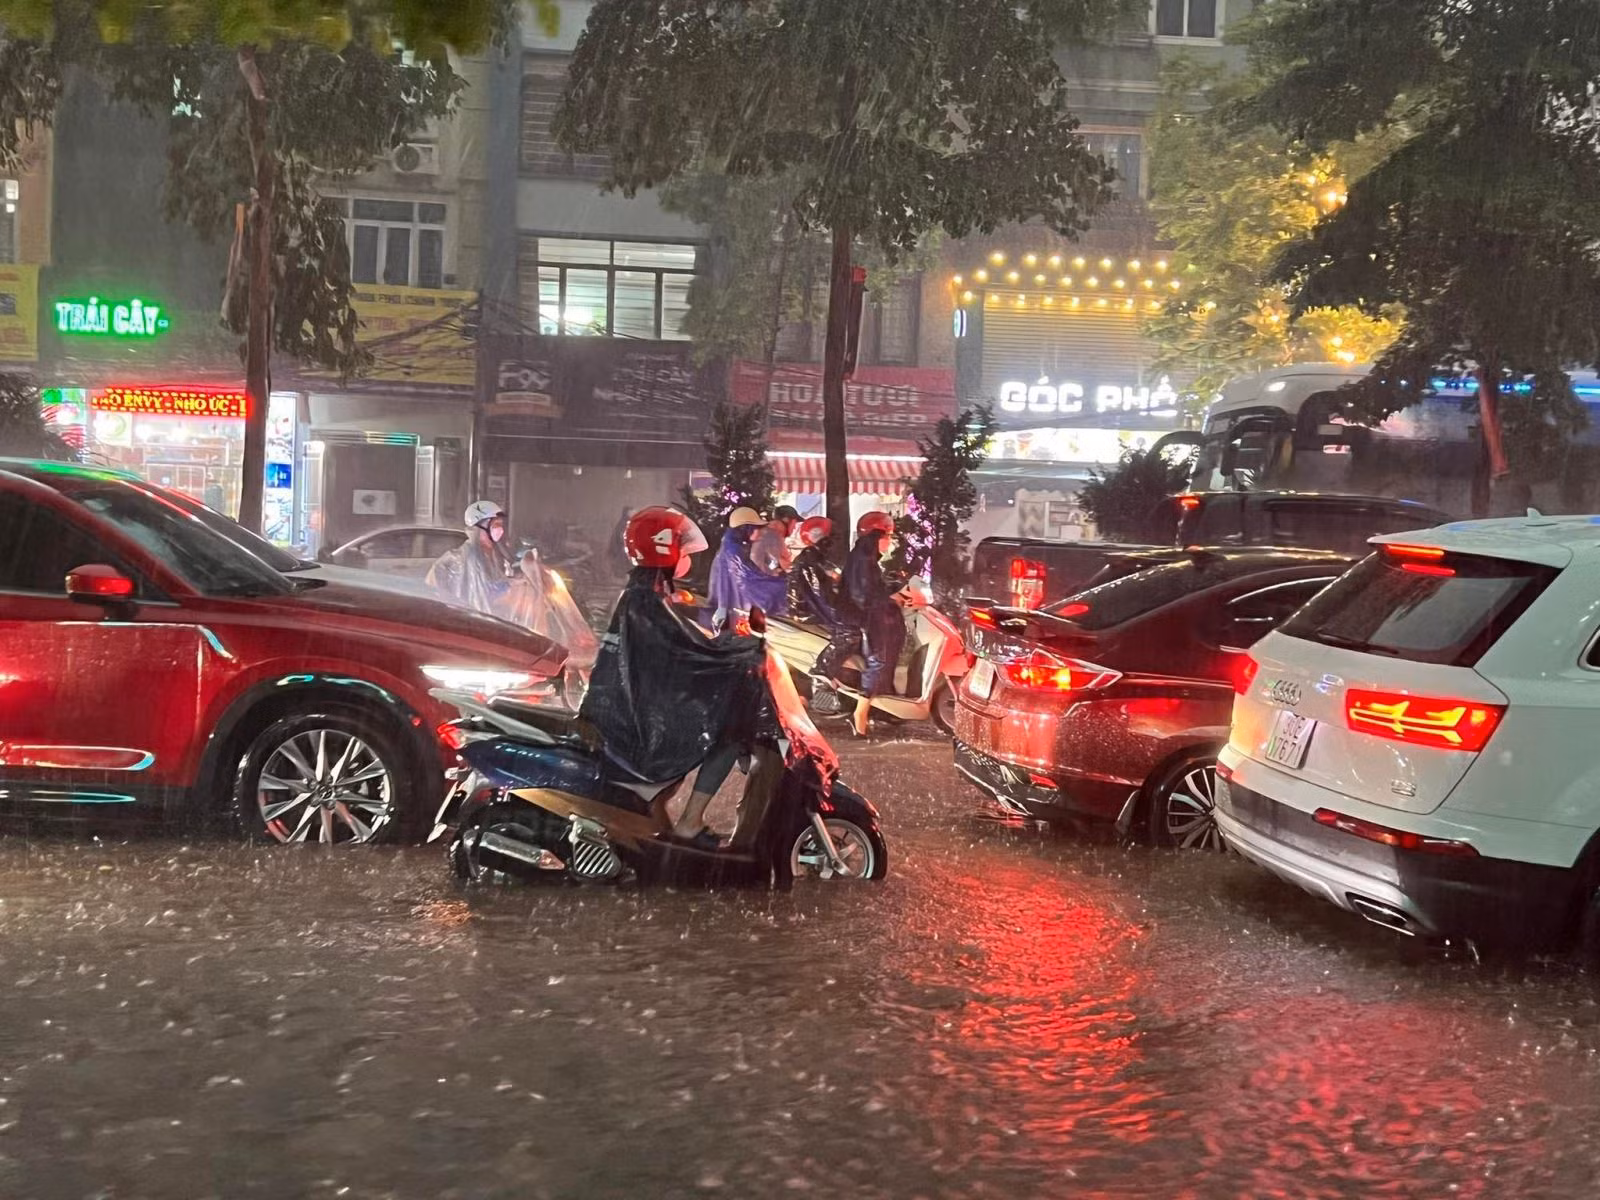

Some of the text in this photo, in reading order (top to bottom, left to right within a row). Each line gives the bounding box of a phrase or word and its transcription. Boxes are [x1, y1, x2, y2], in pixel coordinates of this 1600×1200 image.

[124, 394, 163, 408] ENVY
[174, 397, 206, 410] NHO
[1000, 375, 1084, 412] GÓC
